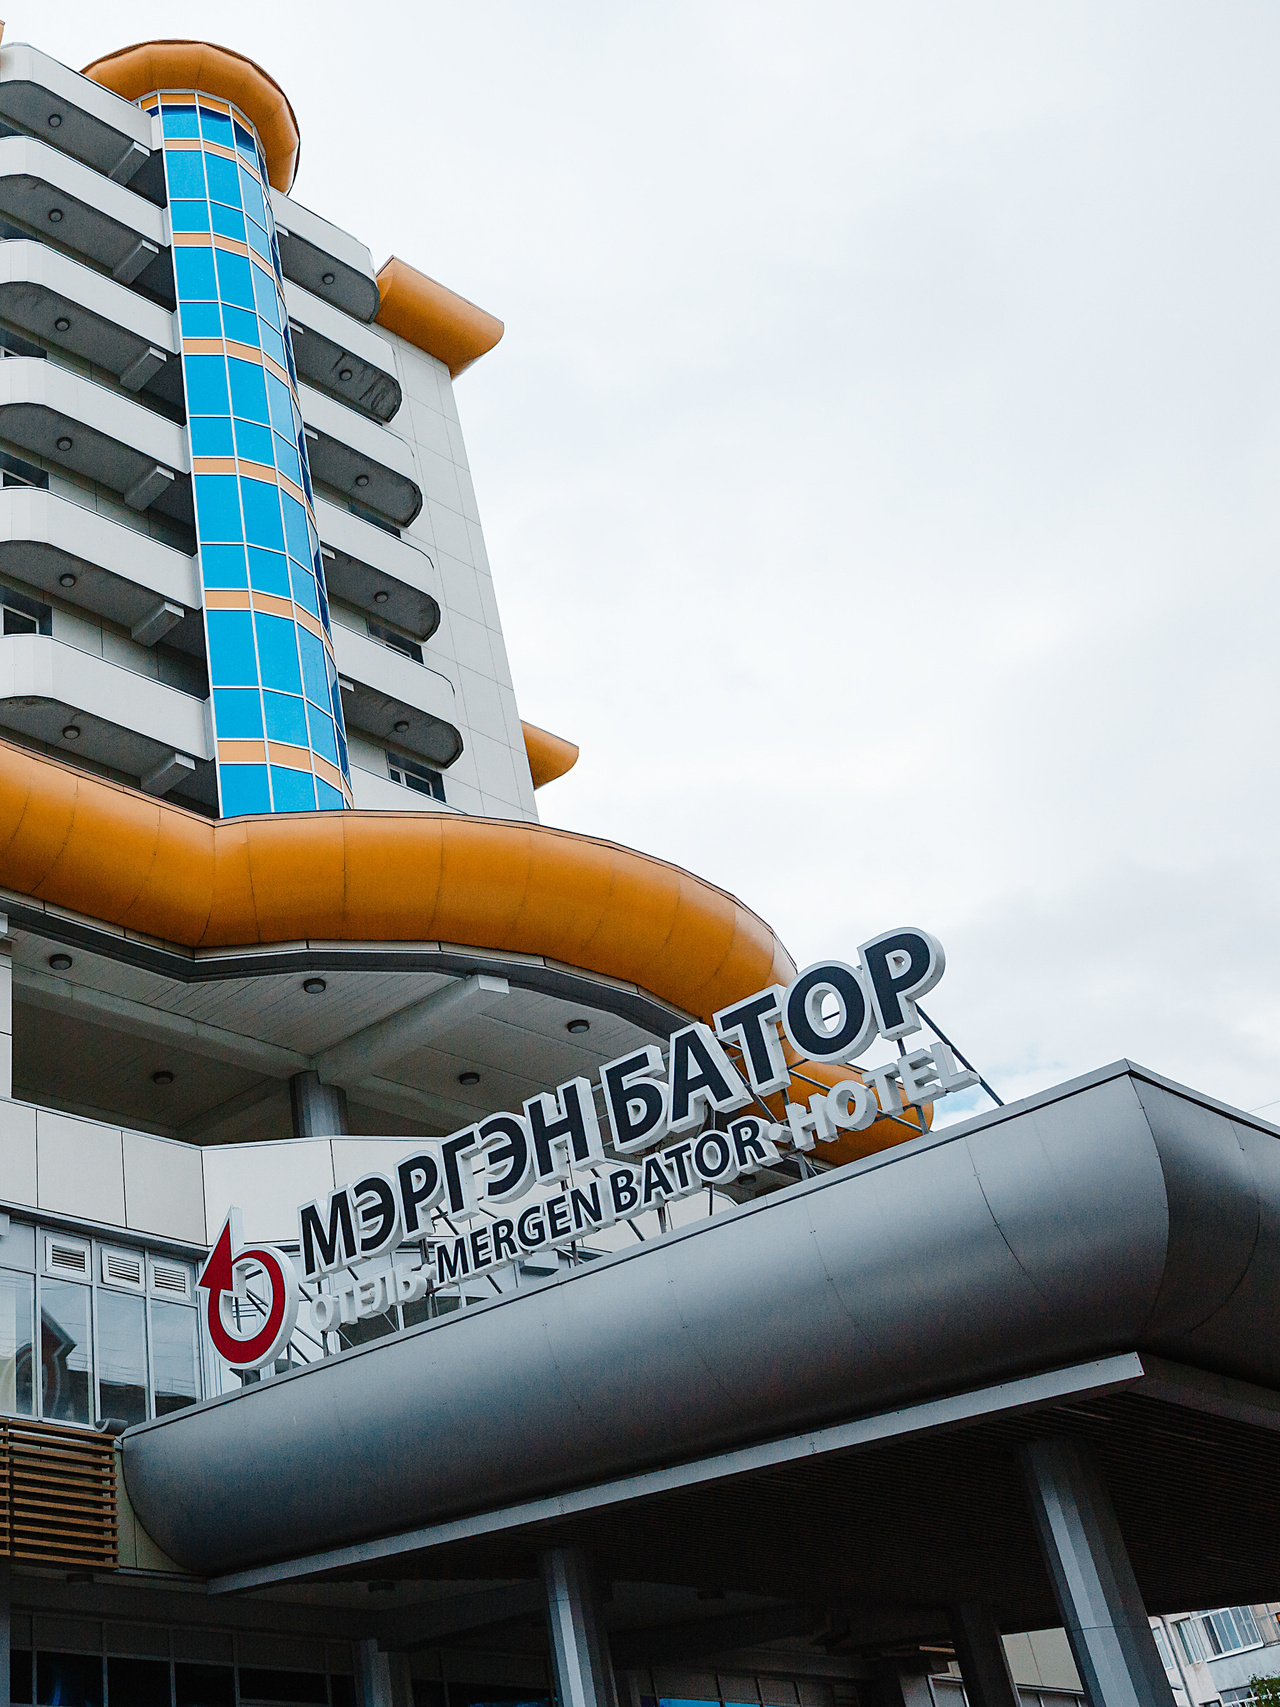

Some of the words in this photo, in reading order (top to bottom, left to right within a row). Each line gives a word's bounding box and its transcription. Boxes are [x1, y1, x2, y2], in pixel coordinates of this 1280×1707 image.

[297, 1076, 604, 1283] МЭРГЭН
[599, 927, 945, 1153] БАТОР
[309, 1265, 427, 1332] ОТЕЛЬ
[434, 1178, 613, 1288] MERGEN
[609, 1115, 781, 1219] BATOR
[785, 1042, 980, 1151] HOTEL
